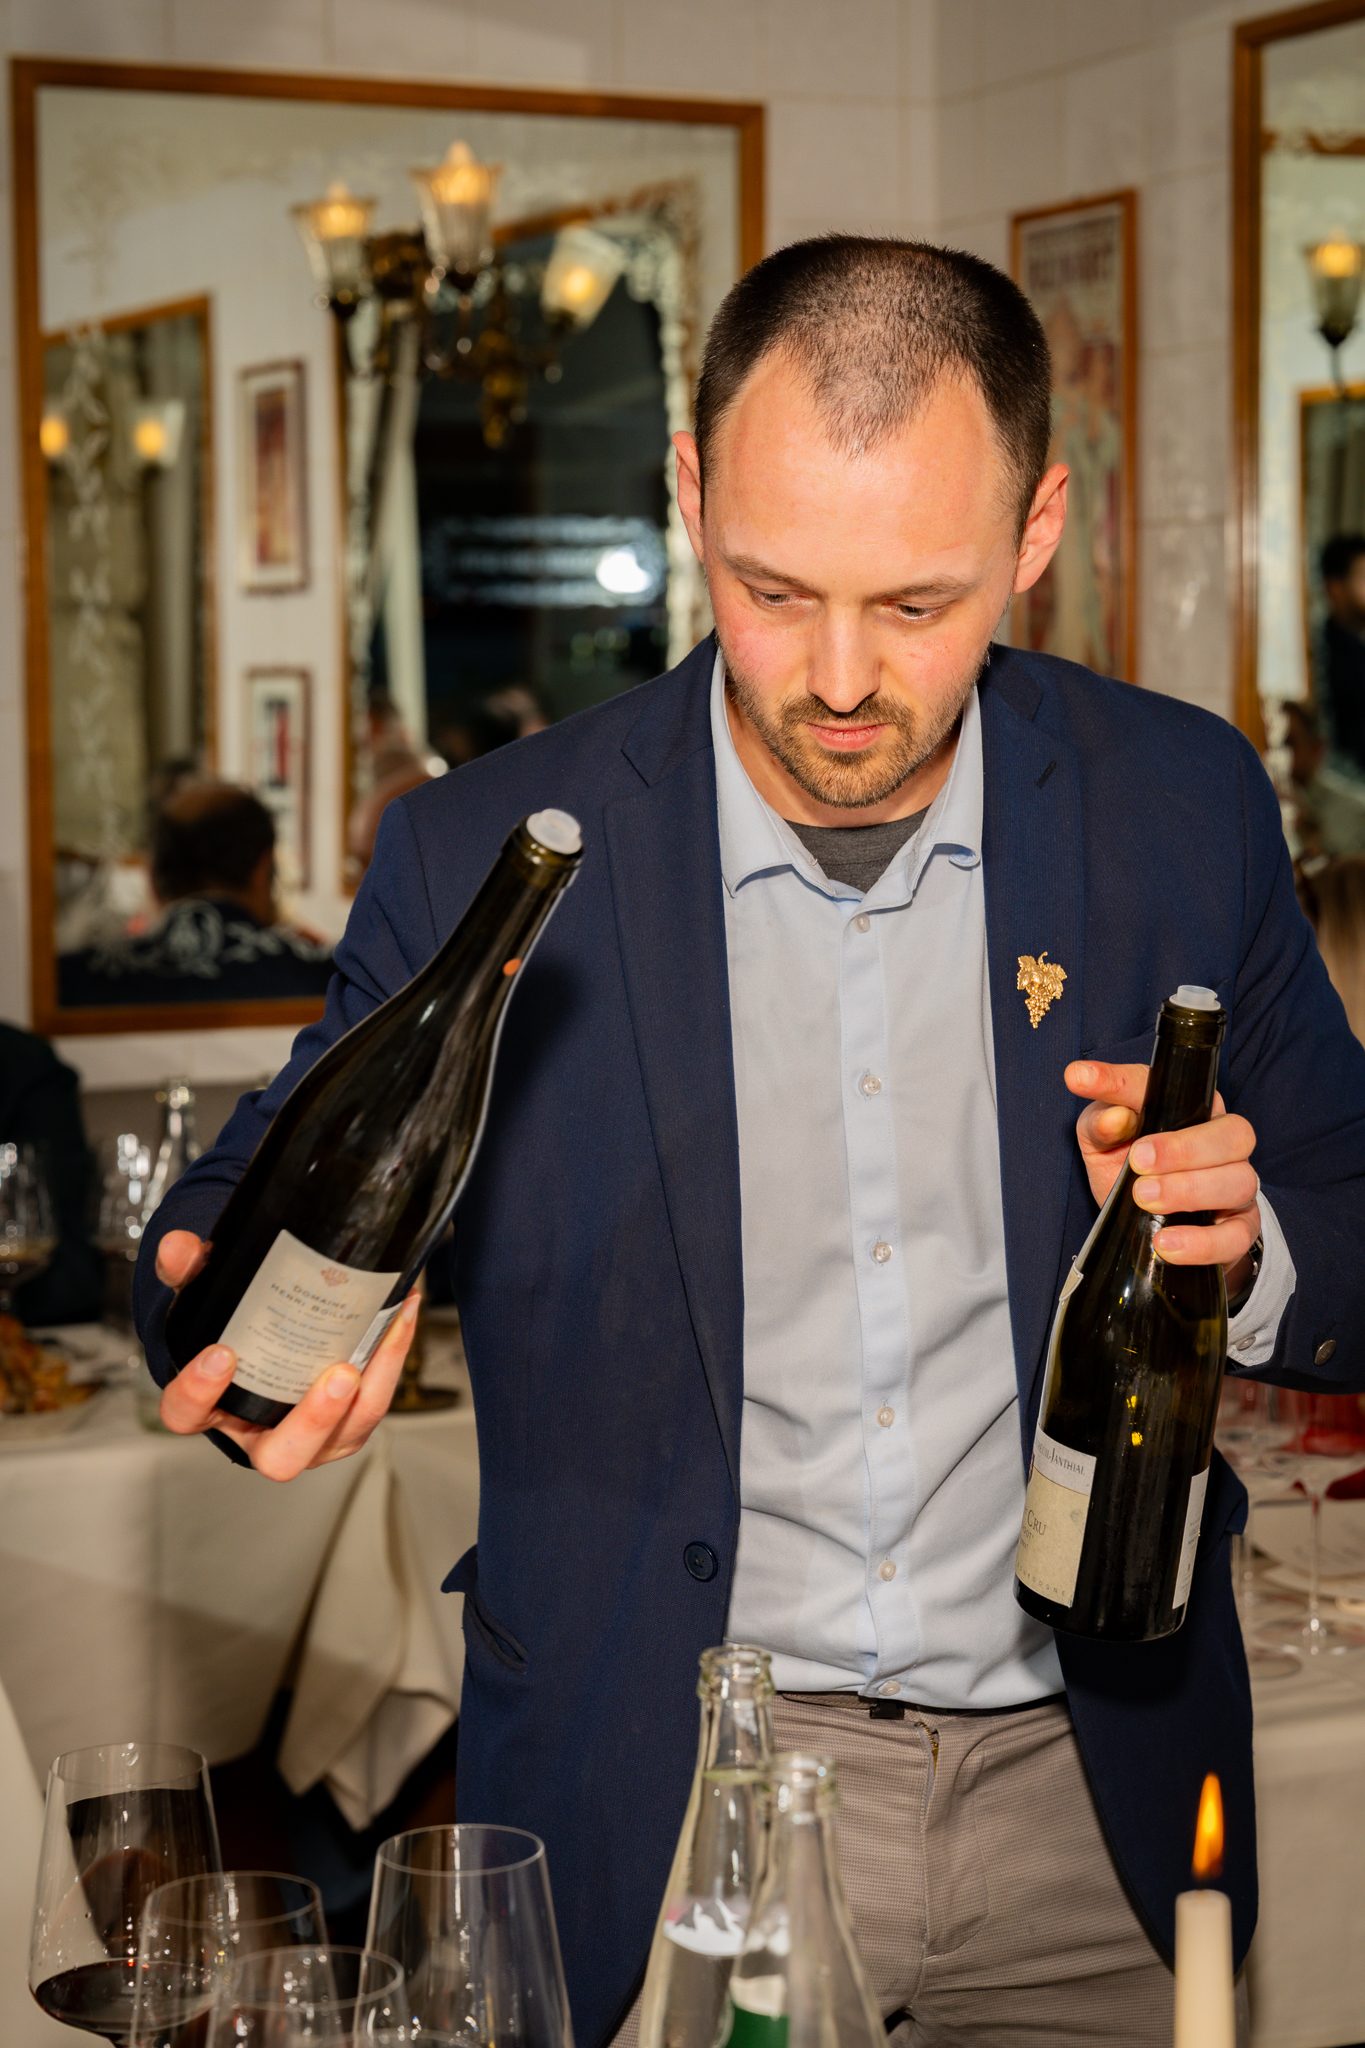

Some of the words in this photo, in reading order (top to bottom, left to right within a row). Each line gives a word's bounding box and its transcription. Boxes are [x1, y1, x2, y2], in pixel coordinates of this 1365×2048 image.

[270, 1282, 306, 1307] HENRI
[292, 1284, 346, 1309] DOMAINE
[1027, 1509, 1047, 1536] CRU
